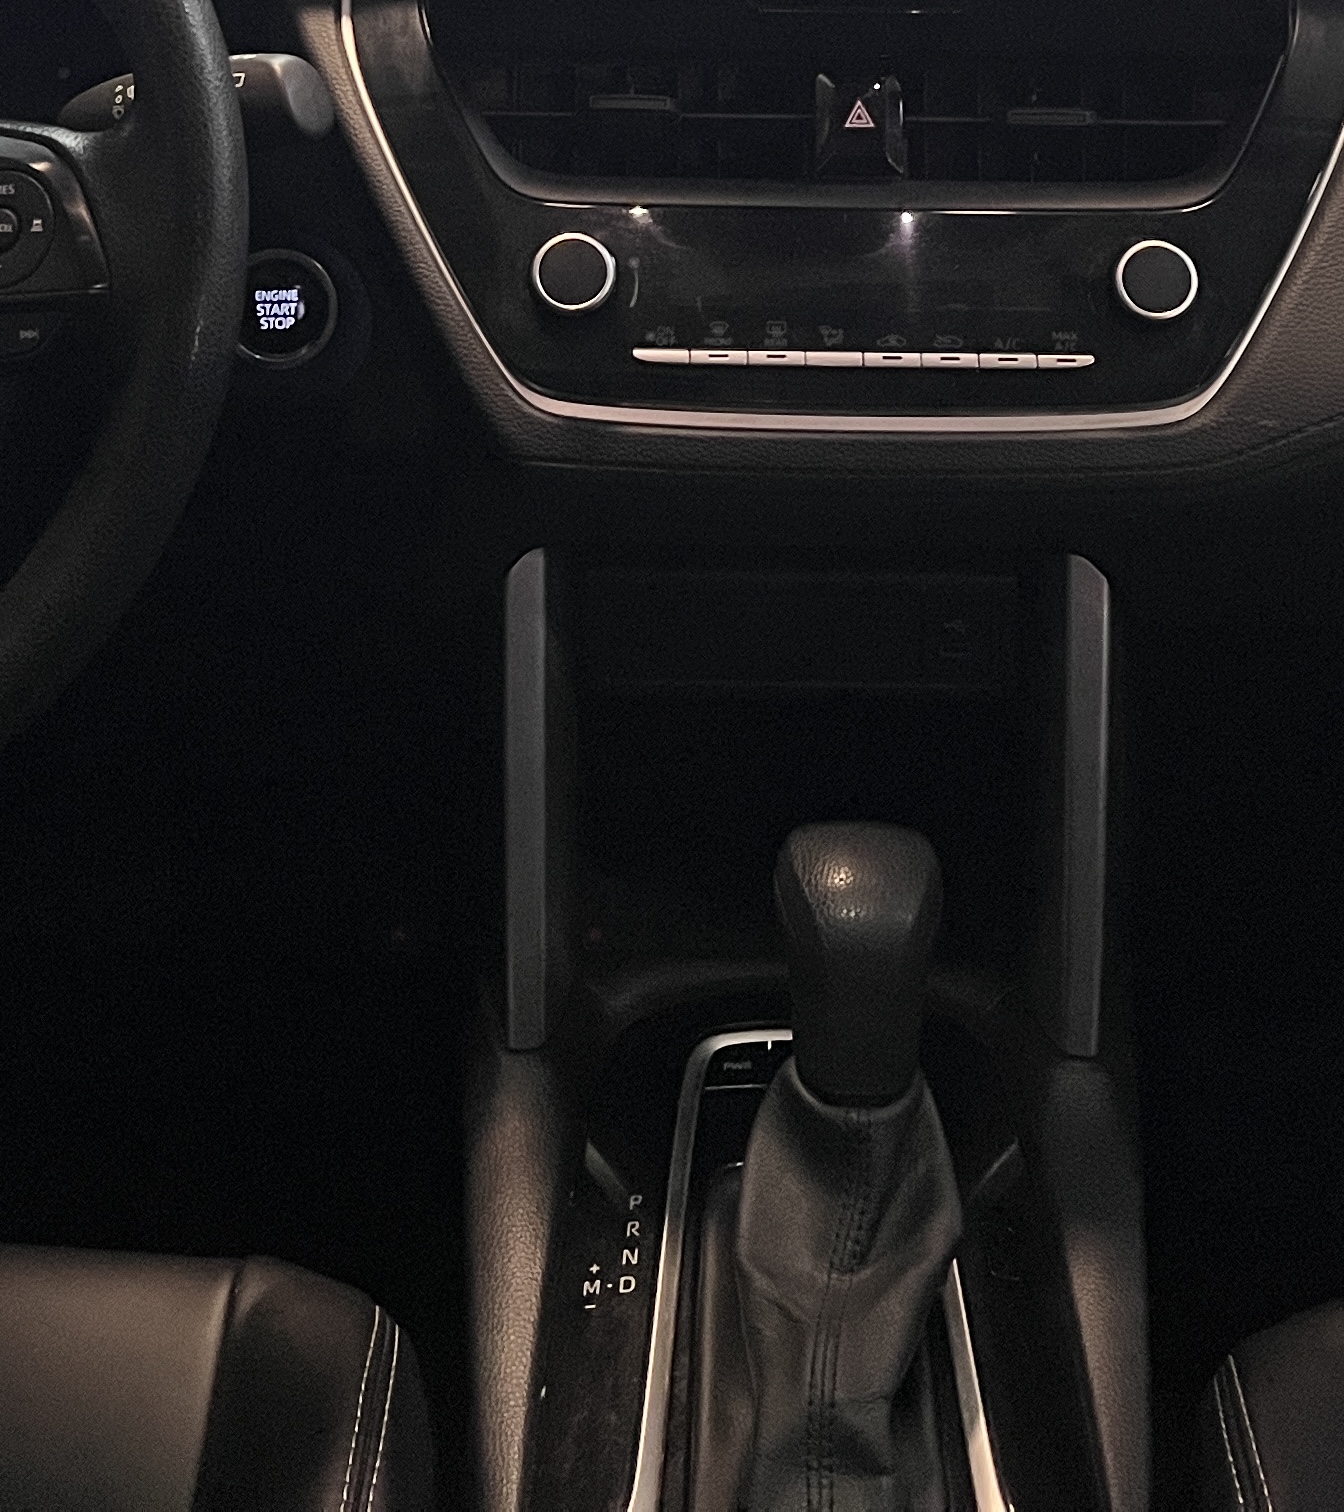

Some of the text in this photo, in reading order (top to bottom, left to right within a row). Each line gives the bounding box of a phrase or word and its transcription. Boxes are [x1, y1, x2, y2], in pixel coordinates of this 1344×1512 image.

[255, 289, 299, 301] ENGINE
[256, 303, 298, 316] START
[260, 317, 295, 330] STOP
[629, 1193, 643, 1211] P
[626, 1221, 640, 1237] R
[622, 1248, 639, 1265] N
[582, 1276, 636, 1295] M D
